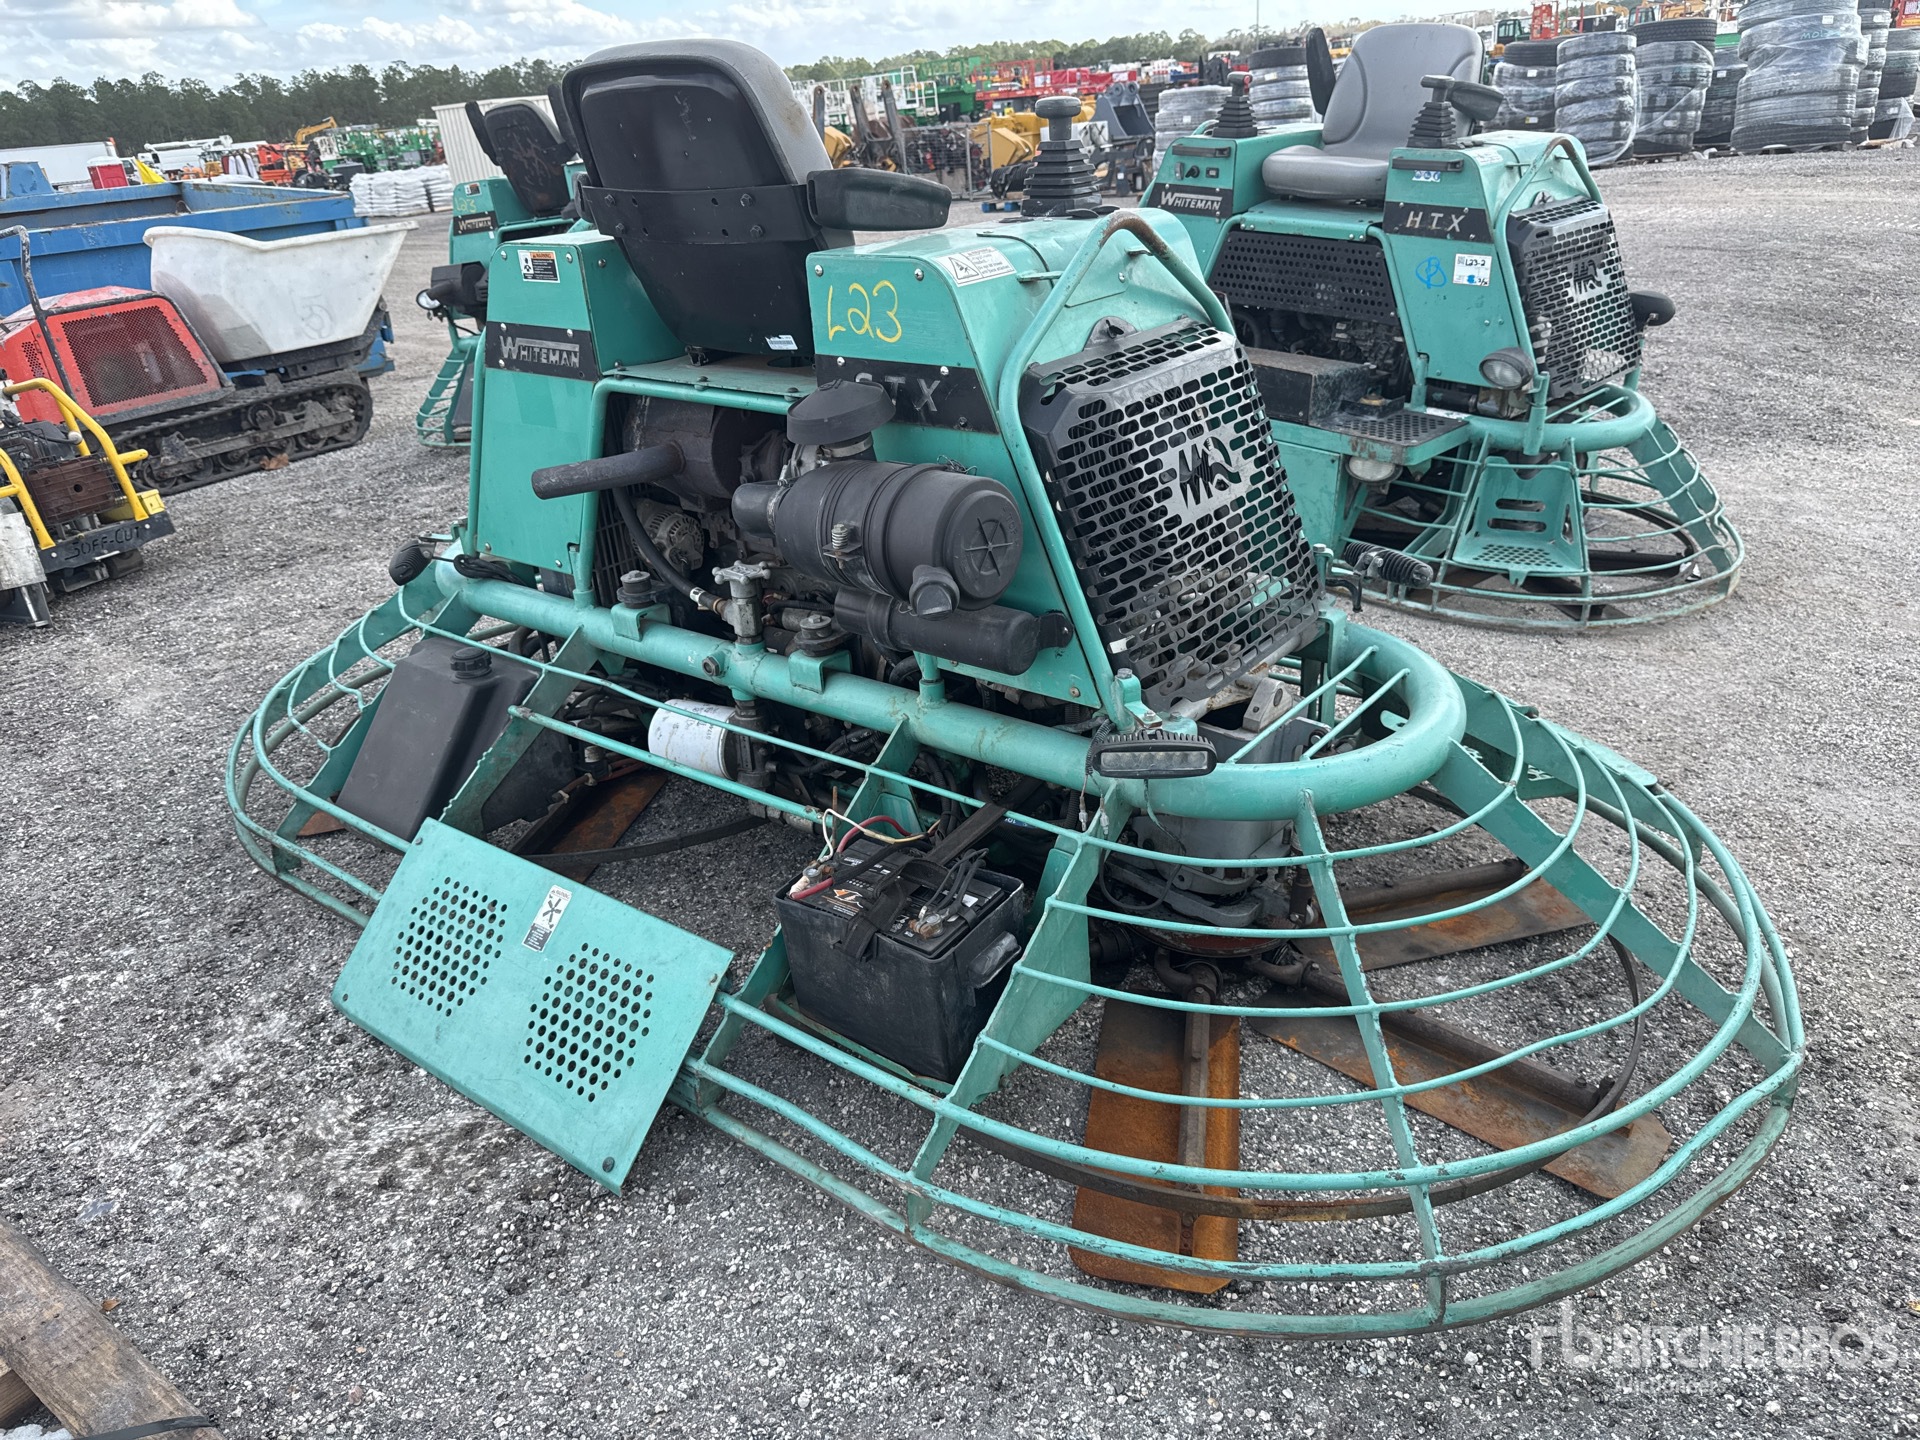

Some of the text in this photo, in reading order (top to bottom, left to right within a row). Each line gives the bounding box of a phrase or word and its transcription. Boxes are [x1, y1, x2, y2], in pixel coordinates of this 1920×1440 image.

[1161, 191, 1222, 210] WHITEMAN
[1406, 211, 1465, 232] HTX
[827, 280, 902, 343] L23
[500, 336, 579, 368] WHITEMAN
[855, 372, 941, 412] TX
[65, 526, 139, 560] SOFF-CUT
